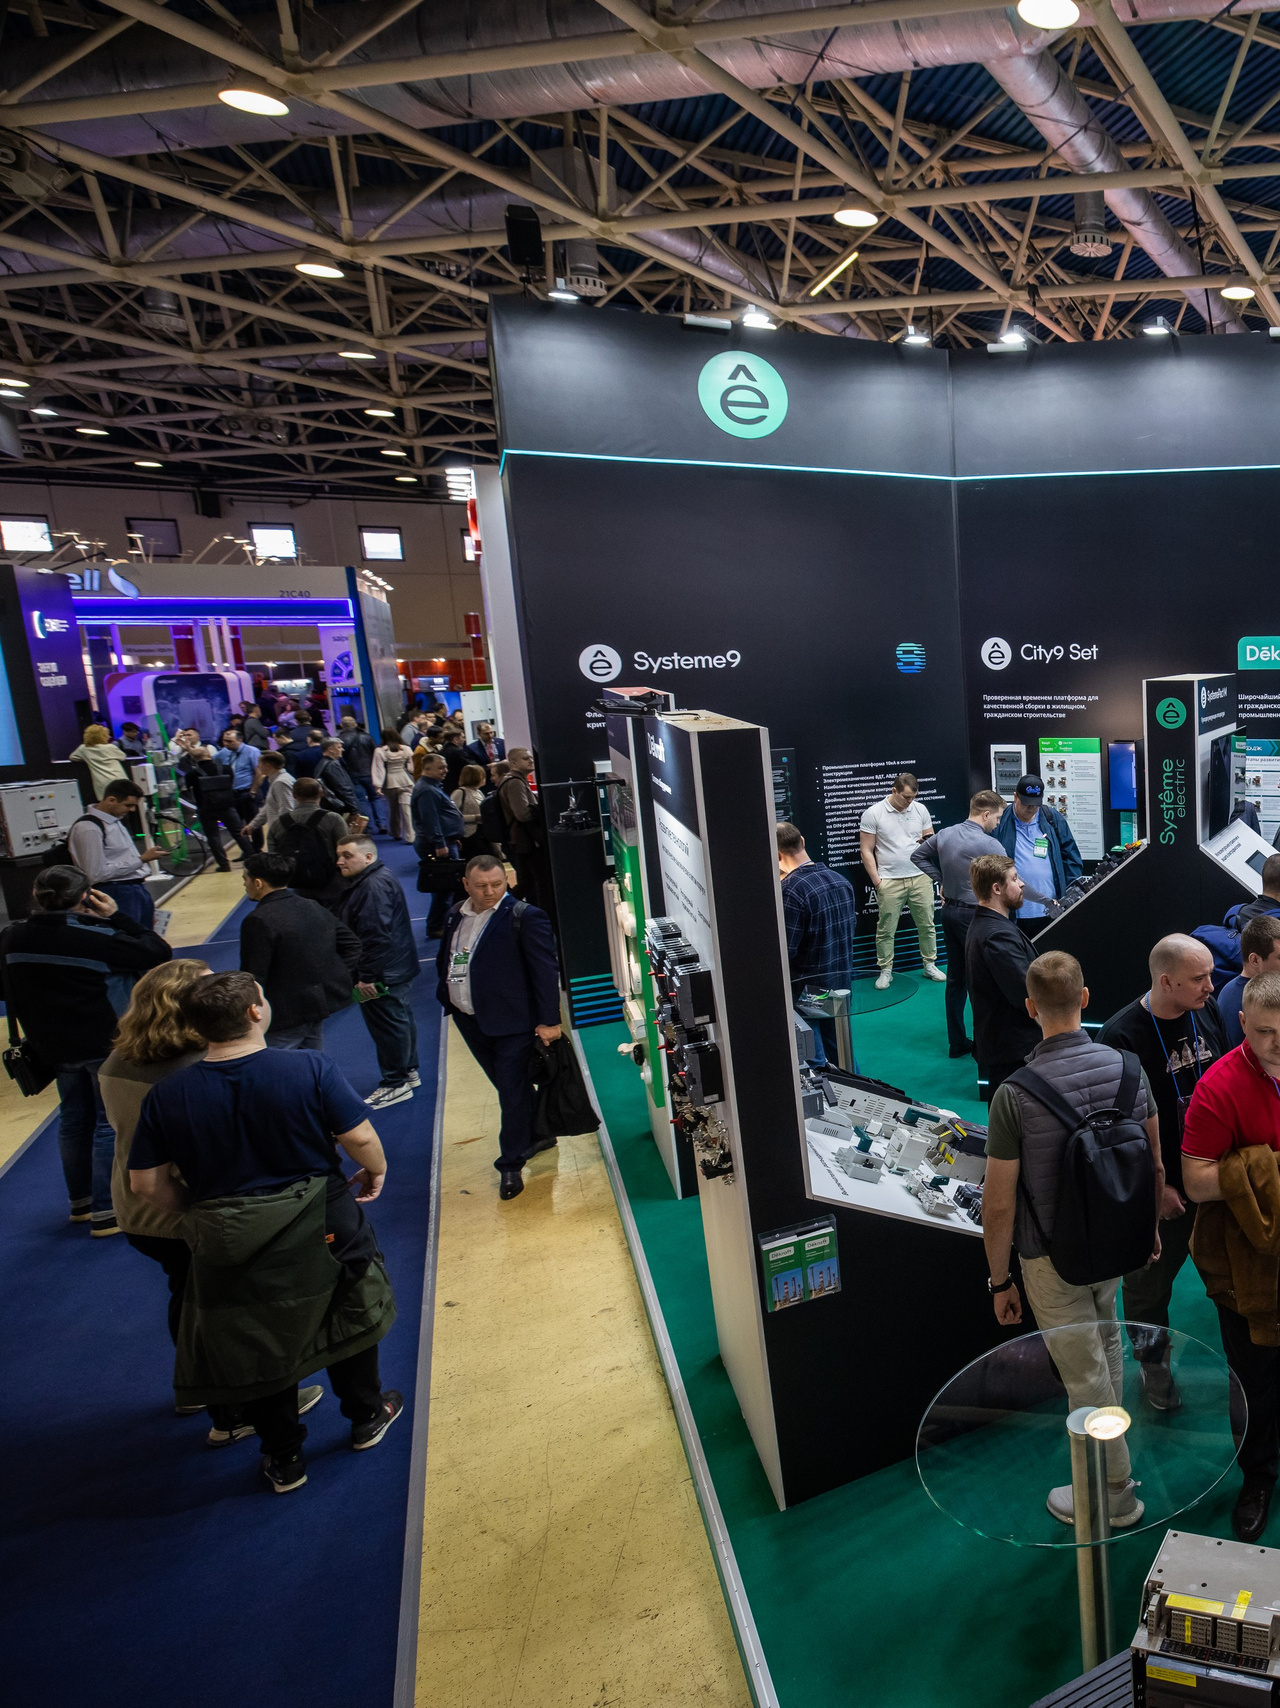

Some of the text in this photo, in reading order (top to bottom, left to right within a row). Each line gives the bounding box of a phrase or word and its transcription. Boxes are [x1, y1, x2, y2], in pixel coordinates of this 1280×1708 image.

[280, 590, 311, 598] 21C40
[634, 650, 741, 673] Systeme9
[1021, 644, 1064, 663] City9
[1070, 644, 1098, 660] Set
[1175, 759, 1186, 818] electric
[1159, 758, 1177, 845] Systême
